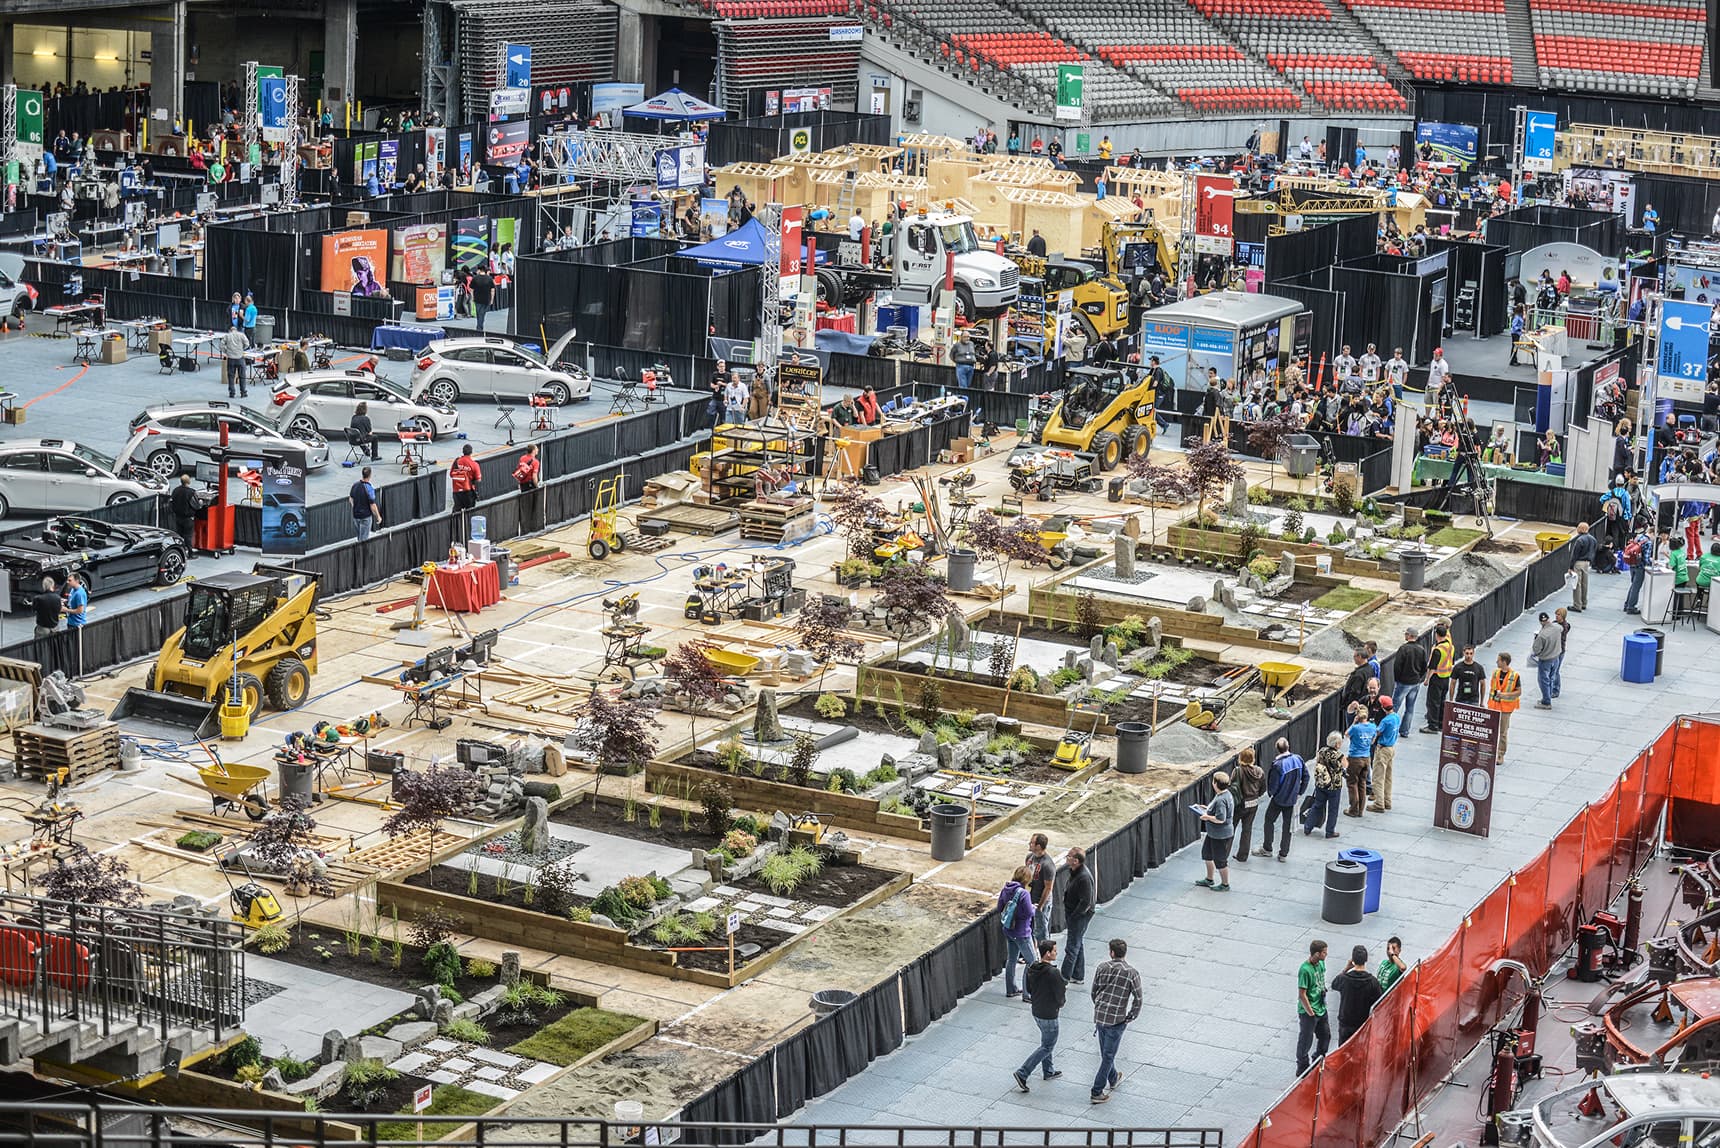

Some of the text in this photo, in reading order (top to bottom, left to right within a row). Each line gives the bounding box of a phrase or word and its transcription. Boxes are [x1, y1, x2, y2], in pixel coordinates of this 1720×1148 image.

[831, 27, 862, 36] WASHROOMS
[518, 78, 529, 87] 20
[1070, 97, 1080, 106] 51
[29, 131, 41, 142] 06
[795, 135, 806, 145] PCL
[1539, 147, 1551, 158] 26
[1213, 223, 1229, 235] 94
[789, 259, 800, 273] 33
[1682, 362, 1703, 377] 37
[1453, 707, 1491, 719] COMPETITION
[1448, 720, 1463, 729] PLAN
[1463, 723, 1475, 731] DES
[1460, 729, 1489, 739] CONCOURS
